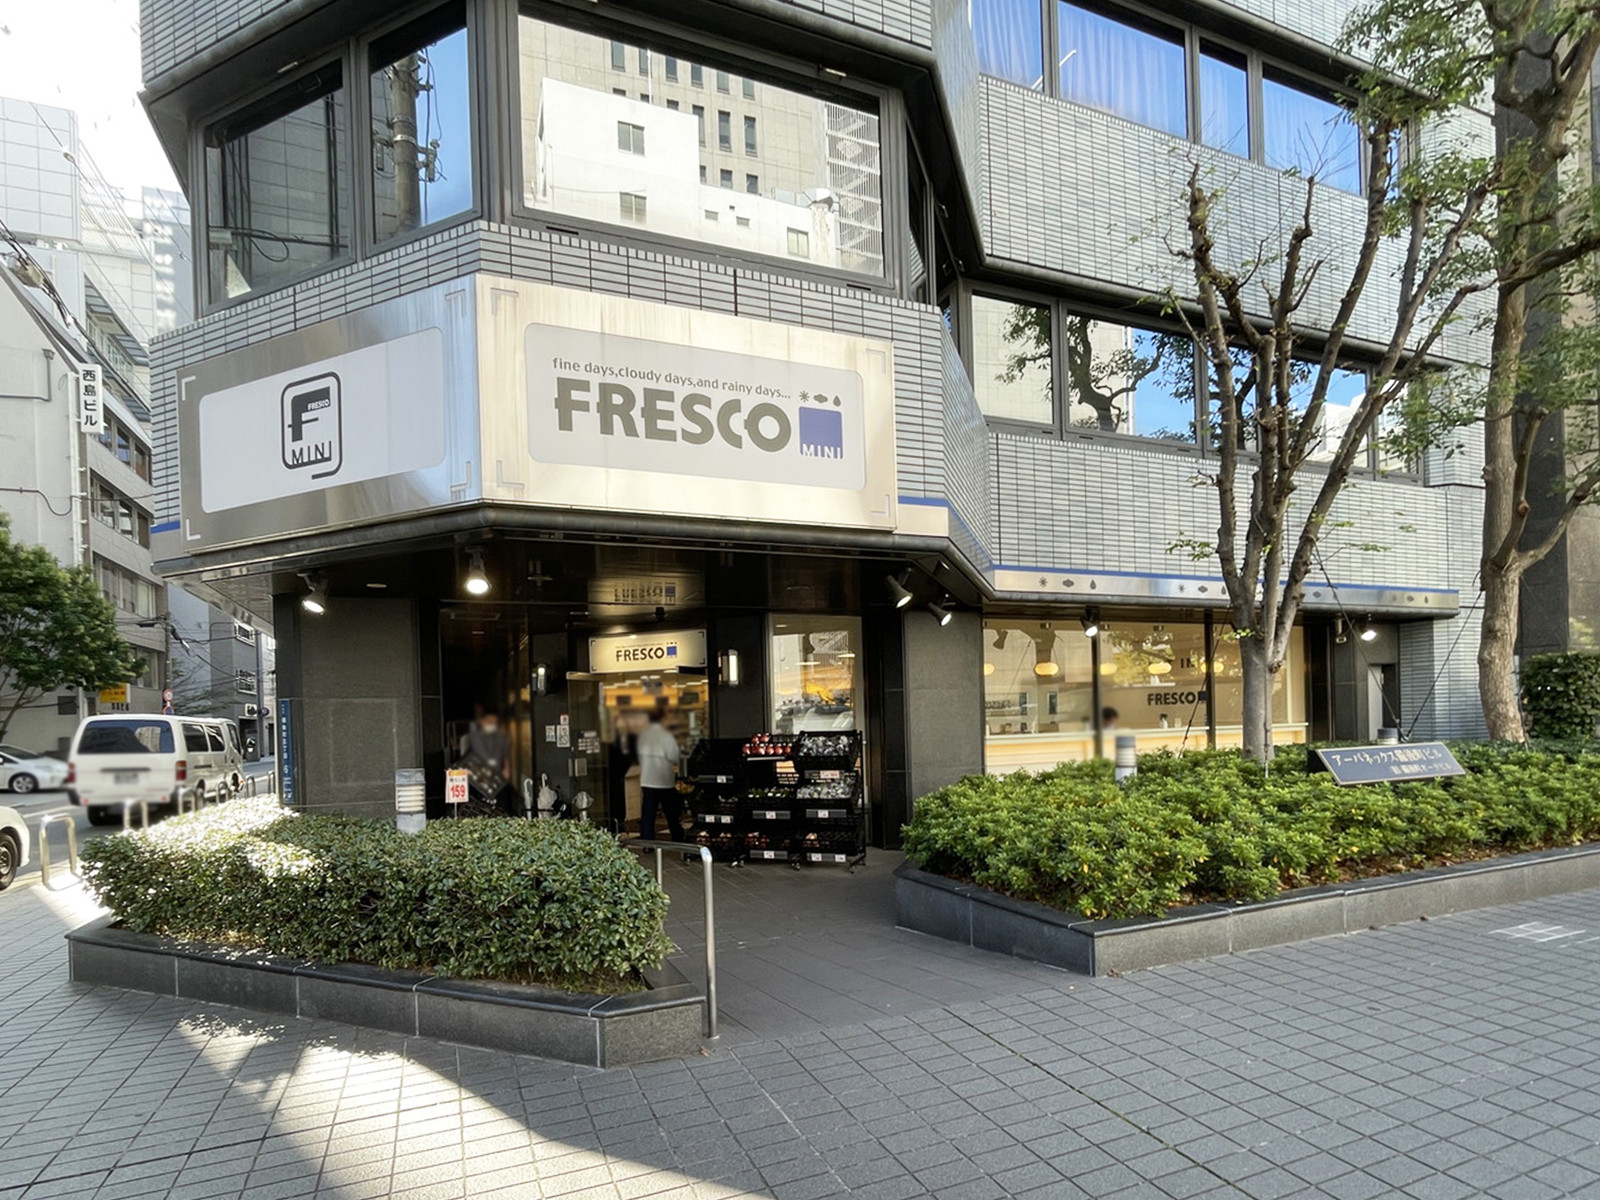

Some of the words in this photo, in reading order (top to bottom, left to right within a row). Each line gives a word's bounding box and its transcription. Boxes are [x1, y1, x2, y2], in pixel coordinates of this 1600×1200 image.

[553, 358, 581, 372] fine
[584, 362, 662, 383] days,cloudy
[664, 372, 719, 389] days,and
[722, 381, 752, 395] rainy
[755, 384, 791, 399] days...
[82, 369, 98, 426] 西島ビル
[307, 398, 330, 411] FRESCO
[554, 376, 791, 453] FRESCO
[291, 440, 332, 466] MINI
[802, 443, 842, 460] MINI
[616, 647, 665, 662] FRESCO
[1147, 691, 1196, 706] FRESCO
[450, 784, 466, 799] 159
